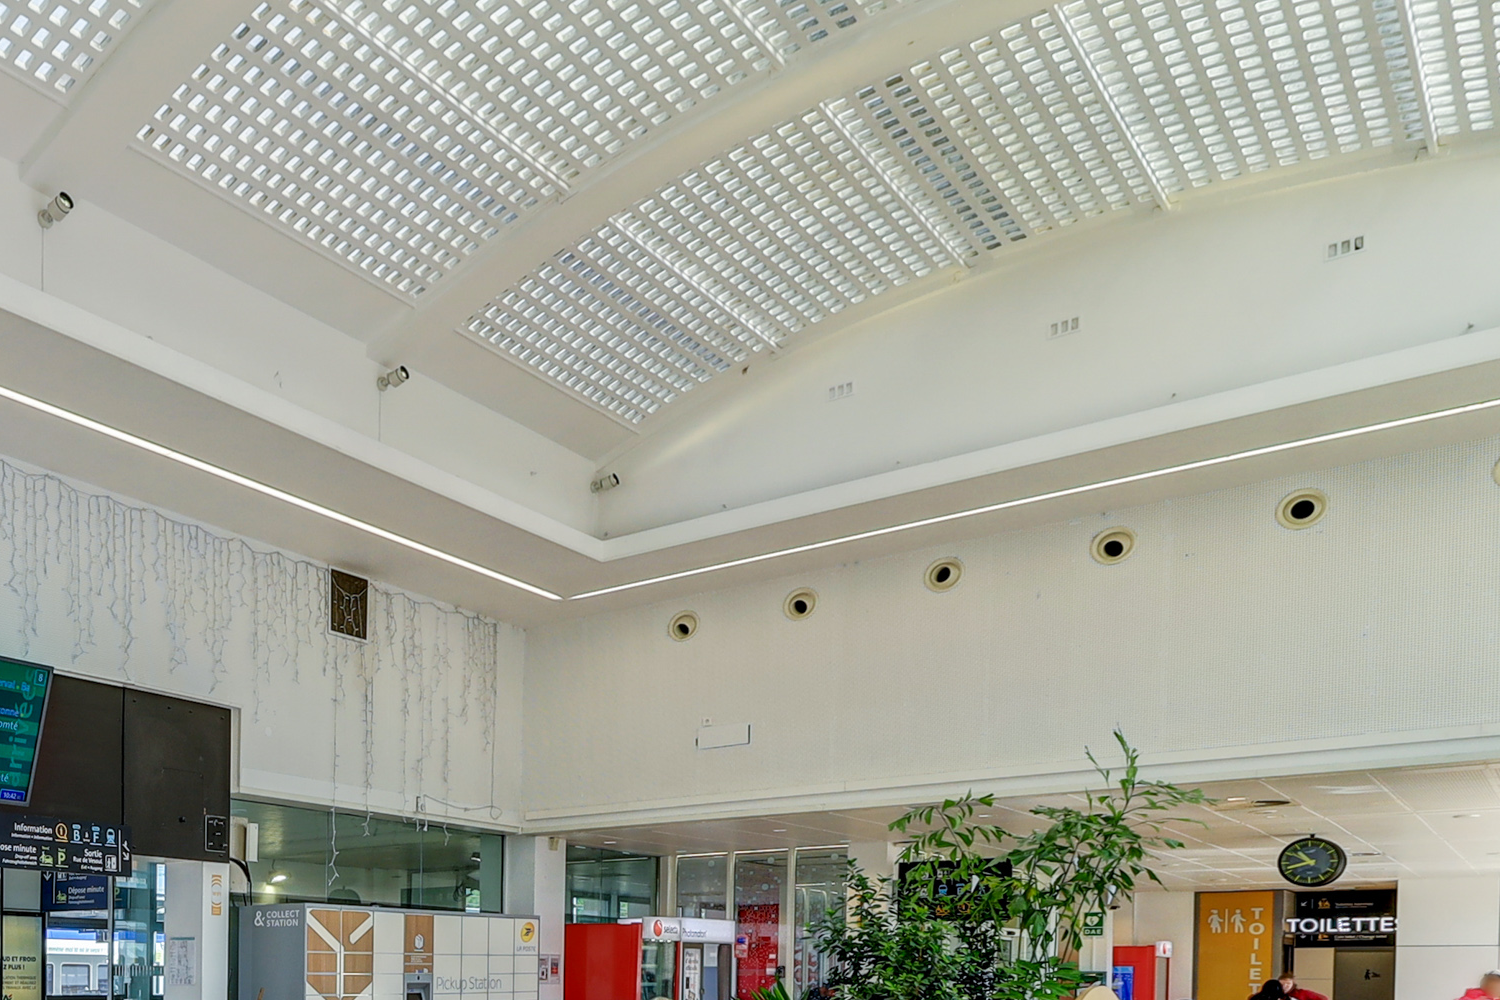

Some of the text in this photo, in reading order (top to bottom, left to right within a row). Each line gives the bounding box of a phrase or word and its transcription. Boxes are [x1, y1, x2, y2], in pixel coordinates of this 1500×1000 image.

[14, 823, 53, 835] Information
[74, 830, 100, 843] B F
[13, 844, 37, 854] minute
[84, 848, 103, 858] Sortie
[266, 910, 300, 919] COLLECT
[266, 919, 299, 928] STATION
[436, 976, 502, 993] Pickup Station
